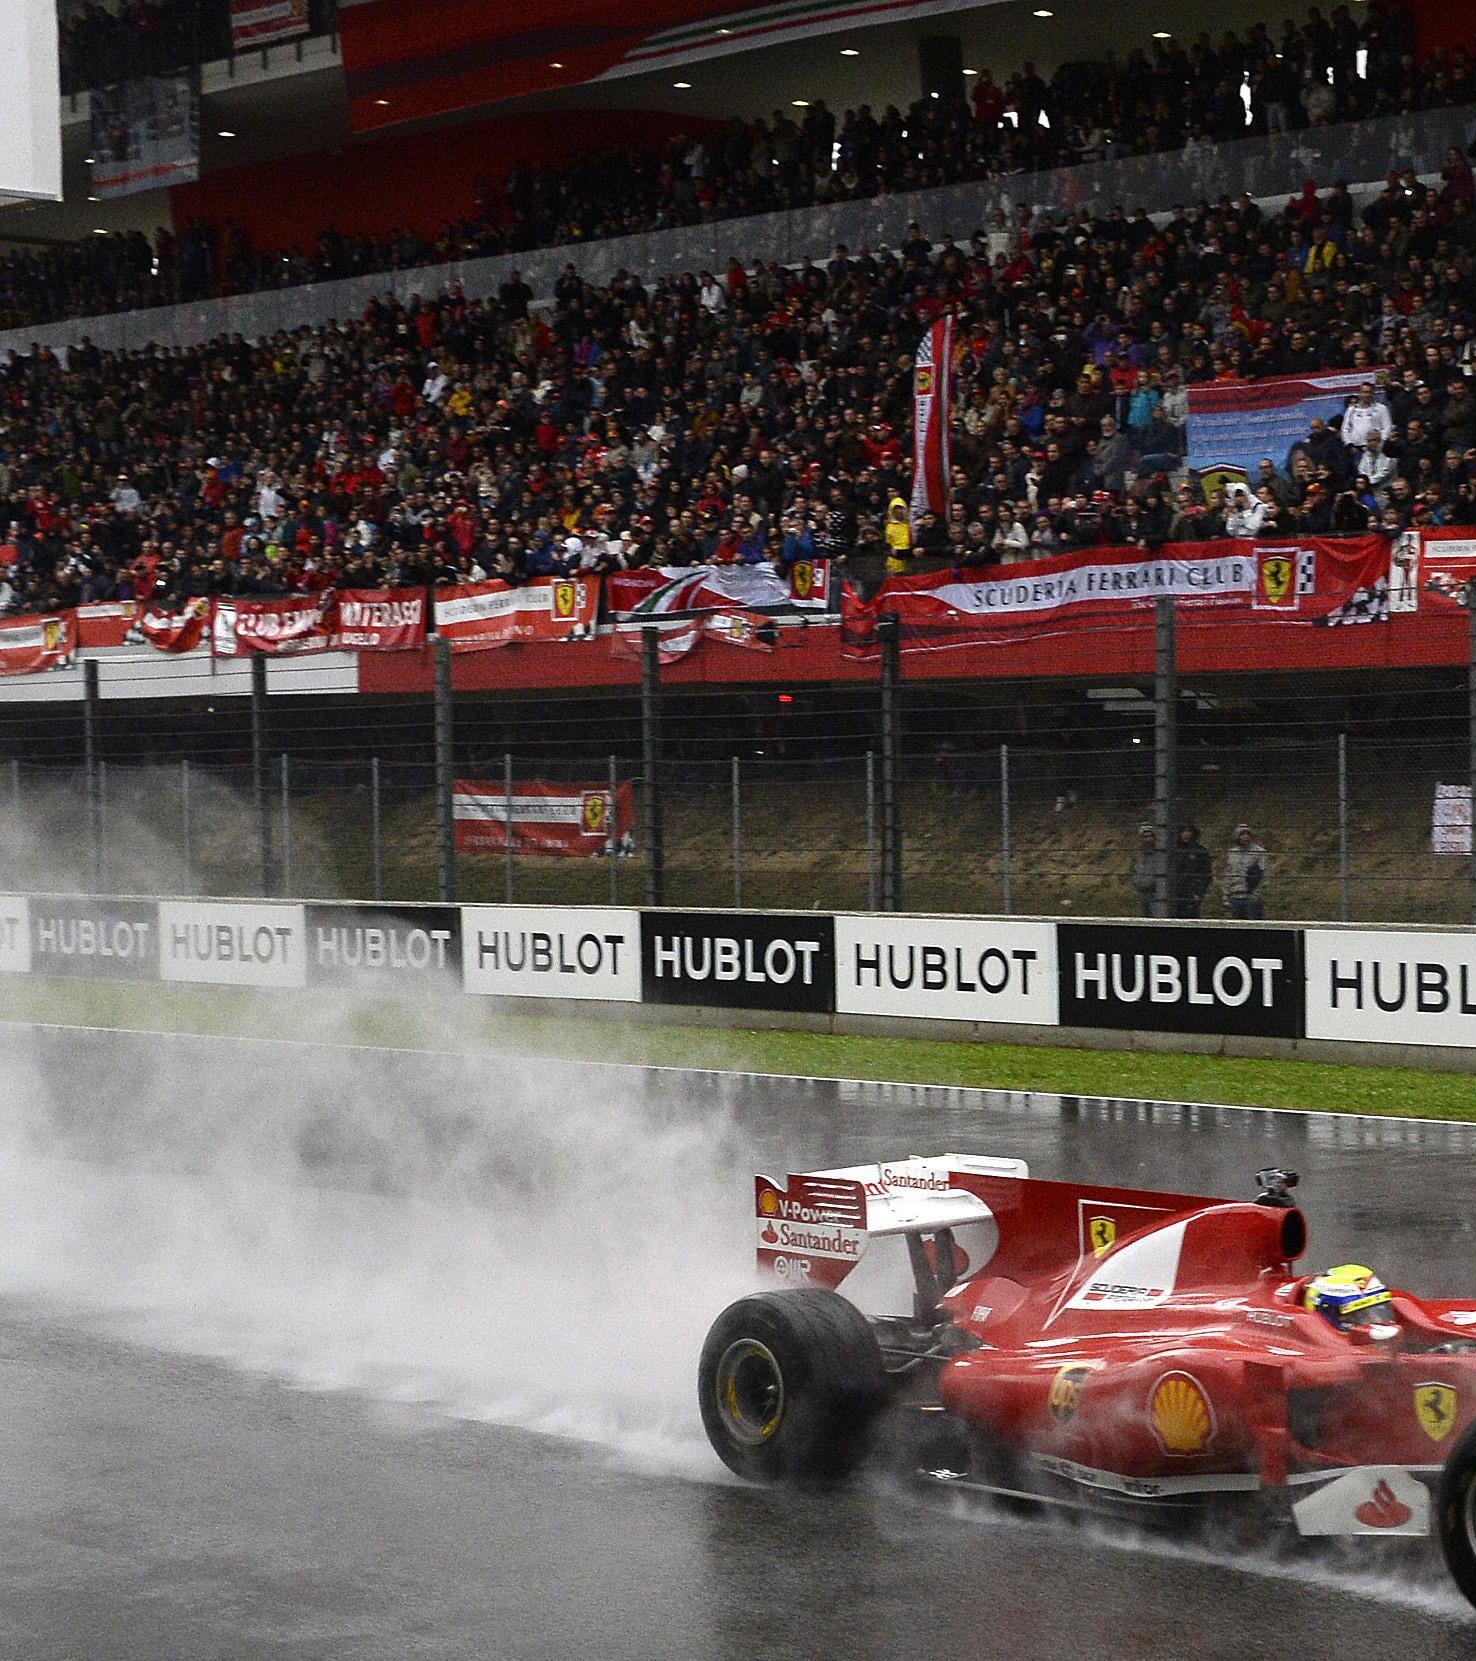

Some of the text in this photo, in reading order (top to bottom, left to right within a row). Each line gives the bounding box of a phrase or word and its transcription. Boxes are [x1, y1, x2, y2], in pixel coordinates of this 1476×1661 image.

[972, 563, 1244, 608] SCUDERIA FERRARI CLUB
[39, 918, 150, 959] HUBLOT
[170, 922, 292, 964] HUBLOT
[316, 927, 450, 970] HUBLOT
[478, 929, 625, 976] HUBLOT
[654, 934, 820, 985] HUBLOT
[855, 941, 1037, 995] HUBLOT
[1074, 952, 1283, 1008] HUBLOT
[884, 1168, 950, 1191] Santander
[780, 1223, 860, 1255] Santander
